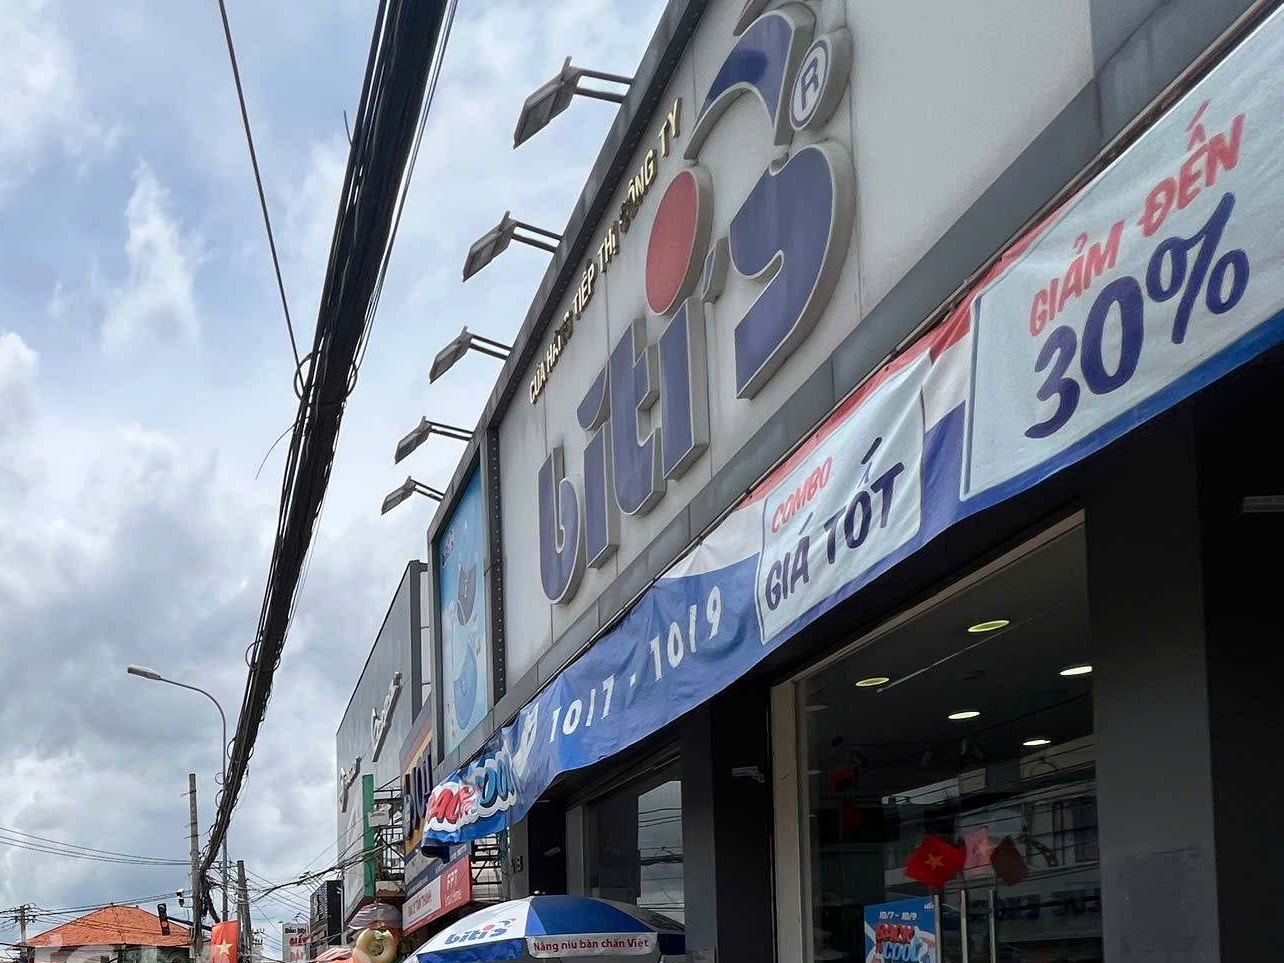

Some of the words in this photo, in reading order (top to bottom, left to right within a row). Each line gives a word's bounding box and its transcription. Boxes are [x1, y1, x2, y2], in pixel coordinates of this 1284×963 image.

[658, 97, 683, 158] TY
[1028, 218, 1124, 337] GIẢM
[1141, 100, 1247, 239] ĐẾN
[1024, 192, 1250, 440] 30%
[765, 528, 814, 612] GIÁ
[824, 436, 906, 569] TỐT
[771, 455, 834, 534] COMBO
[548, 674, 615, 744] 10/7
[649, 585, 722, 682] 10/9
[533, 940, 559, 953] Nâng
[561, 939, 578, 950] niu
[580, 938, 599, 950] bàn
[601, 937, 625, 949] chân
[627, 937, 649, 950] Việt
